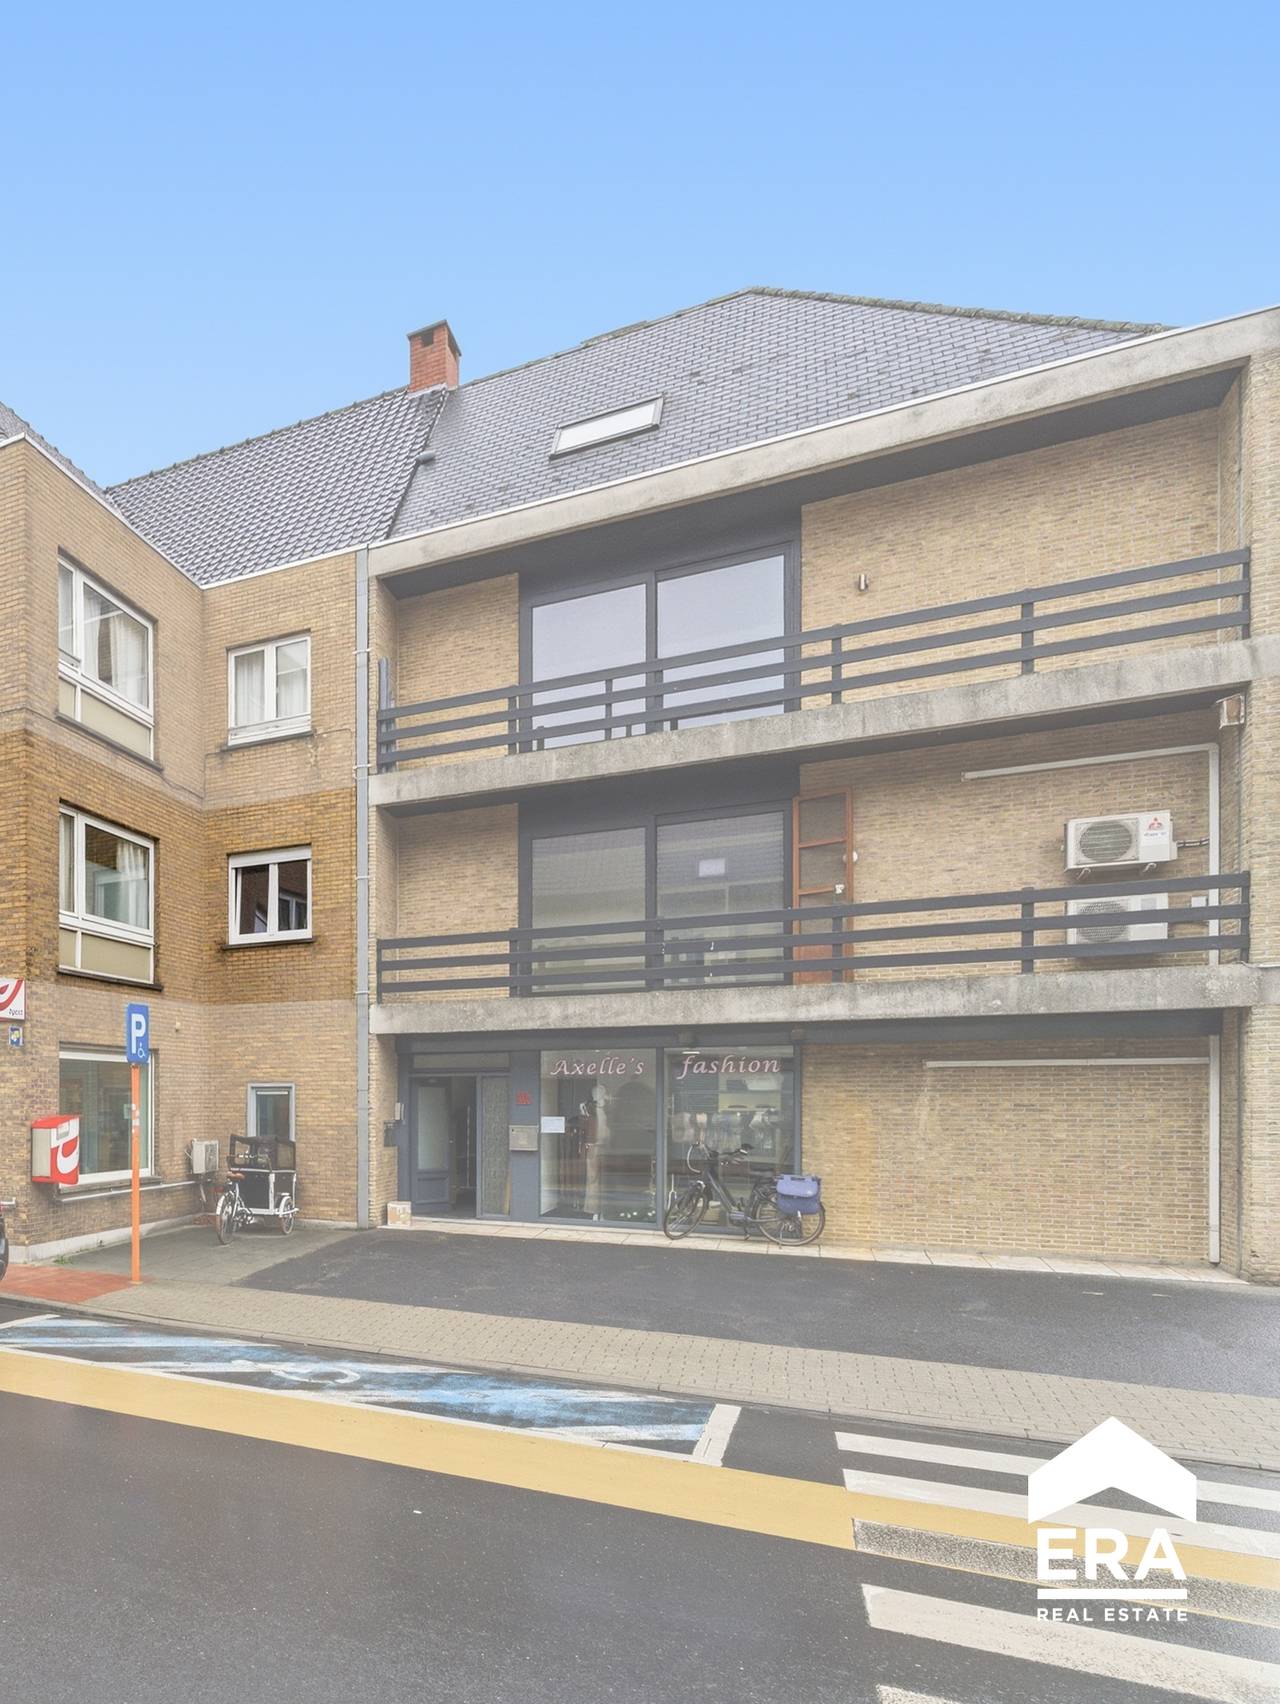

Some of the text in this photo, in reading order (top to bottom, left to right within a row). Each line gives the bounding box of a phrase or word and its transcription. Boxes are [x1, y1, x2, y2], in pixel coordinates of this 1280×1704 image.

[131, 1013, 147, 1054] P
[550, 1055, 782, 1080] Axelle's fashion
